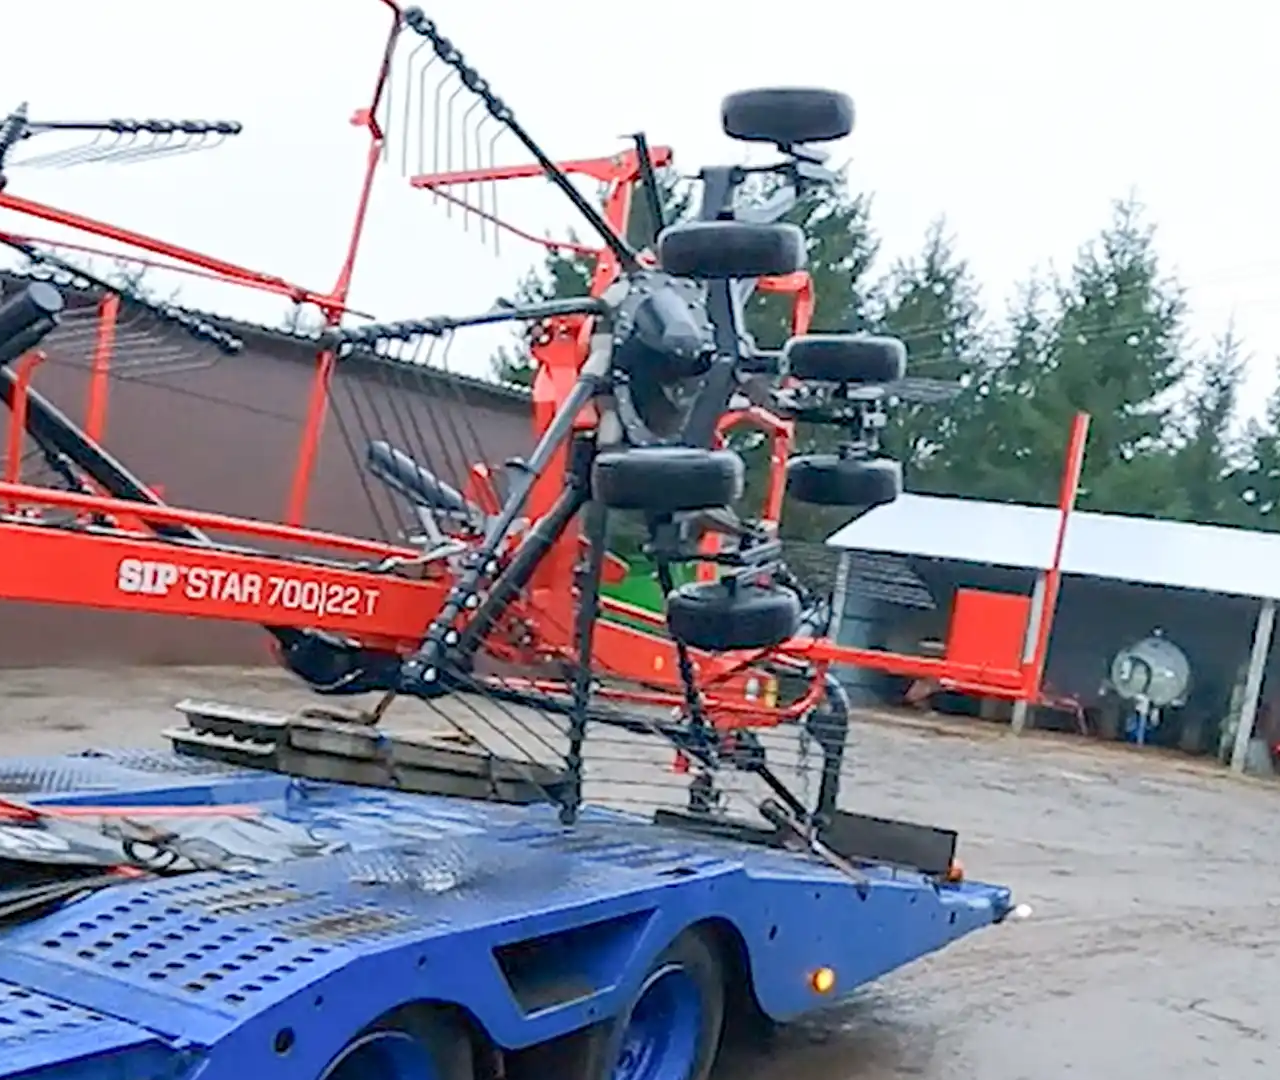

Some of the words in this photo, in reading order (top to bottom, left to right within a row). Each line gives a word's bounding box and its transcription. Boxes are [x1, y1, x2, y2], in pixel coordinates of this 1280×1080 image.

[118, 558, 178, 595] SIP
[185, 566, 263, 605] STAR
[363, 588, 381, 616] T
